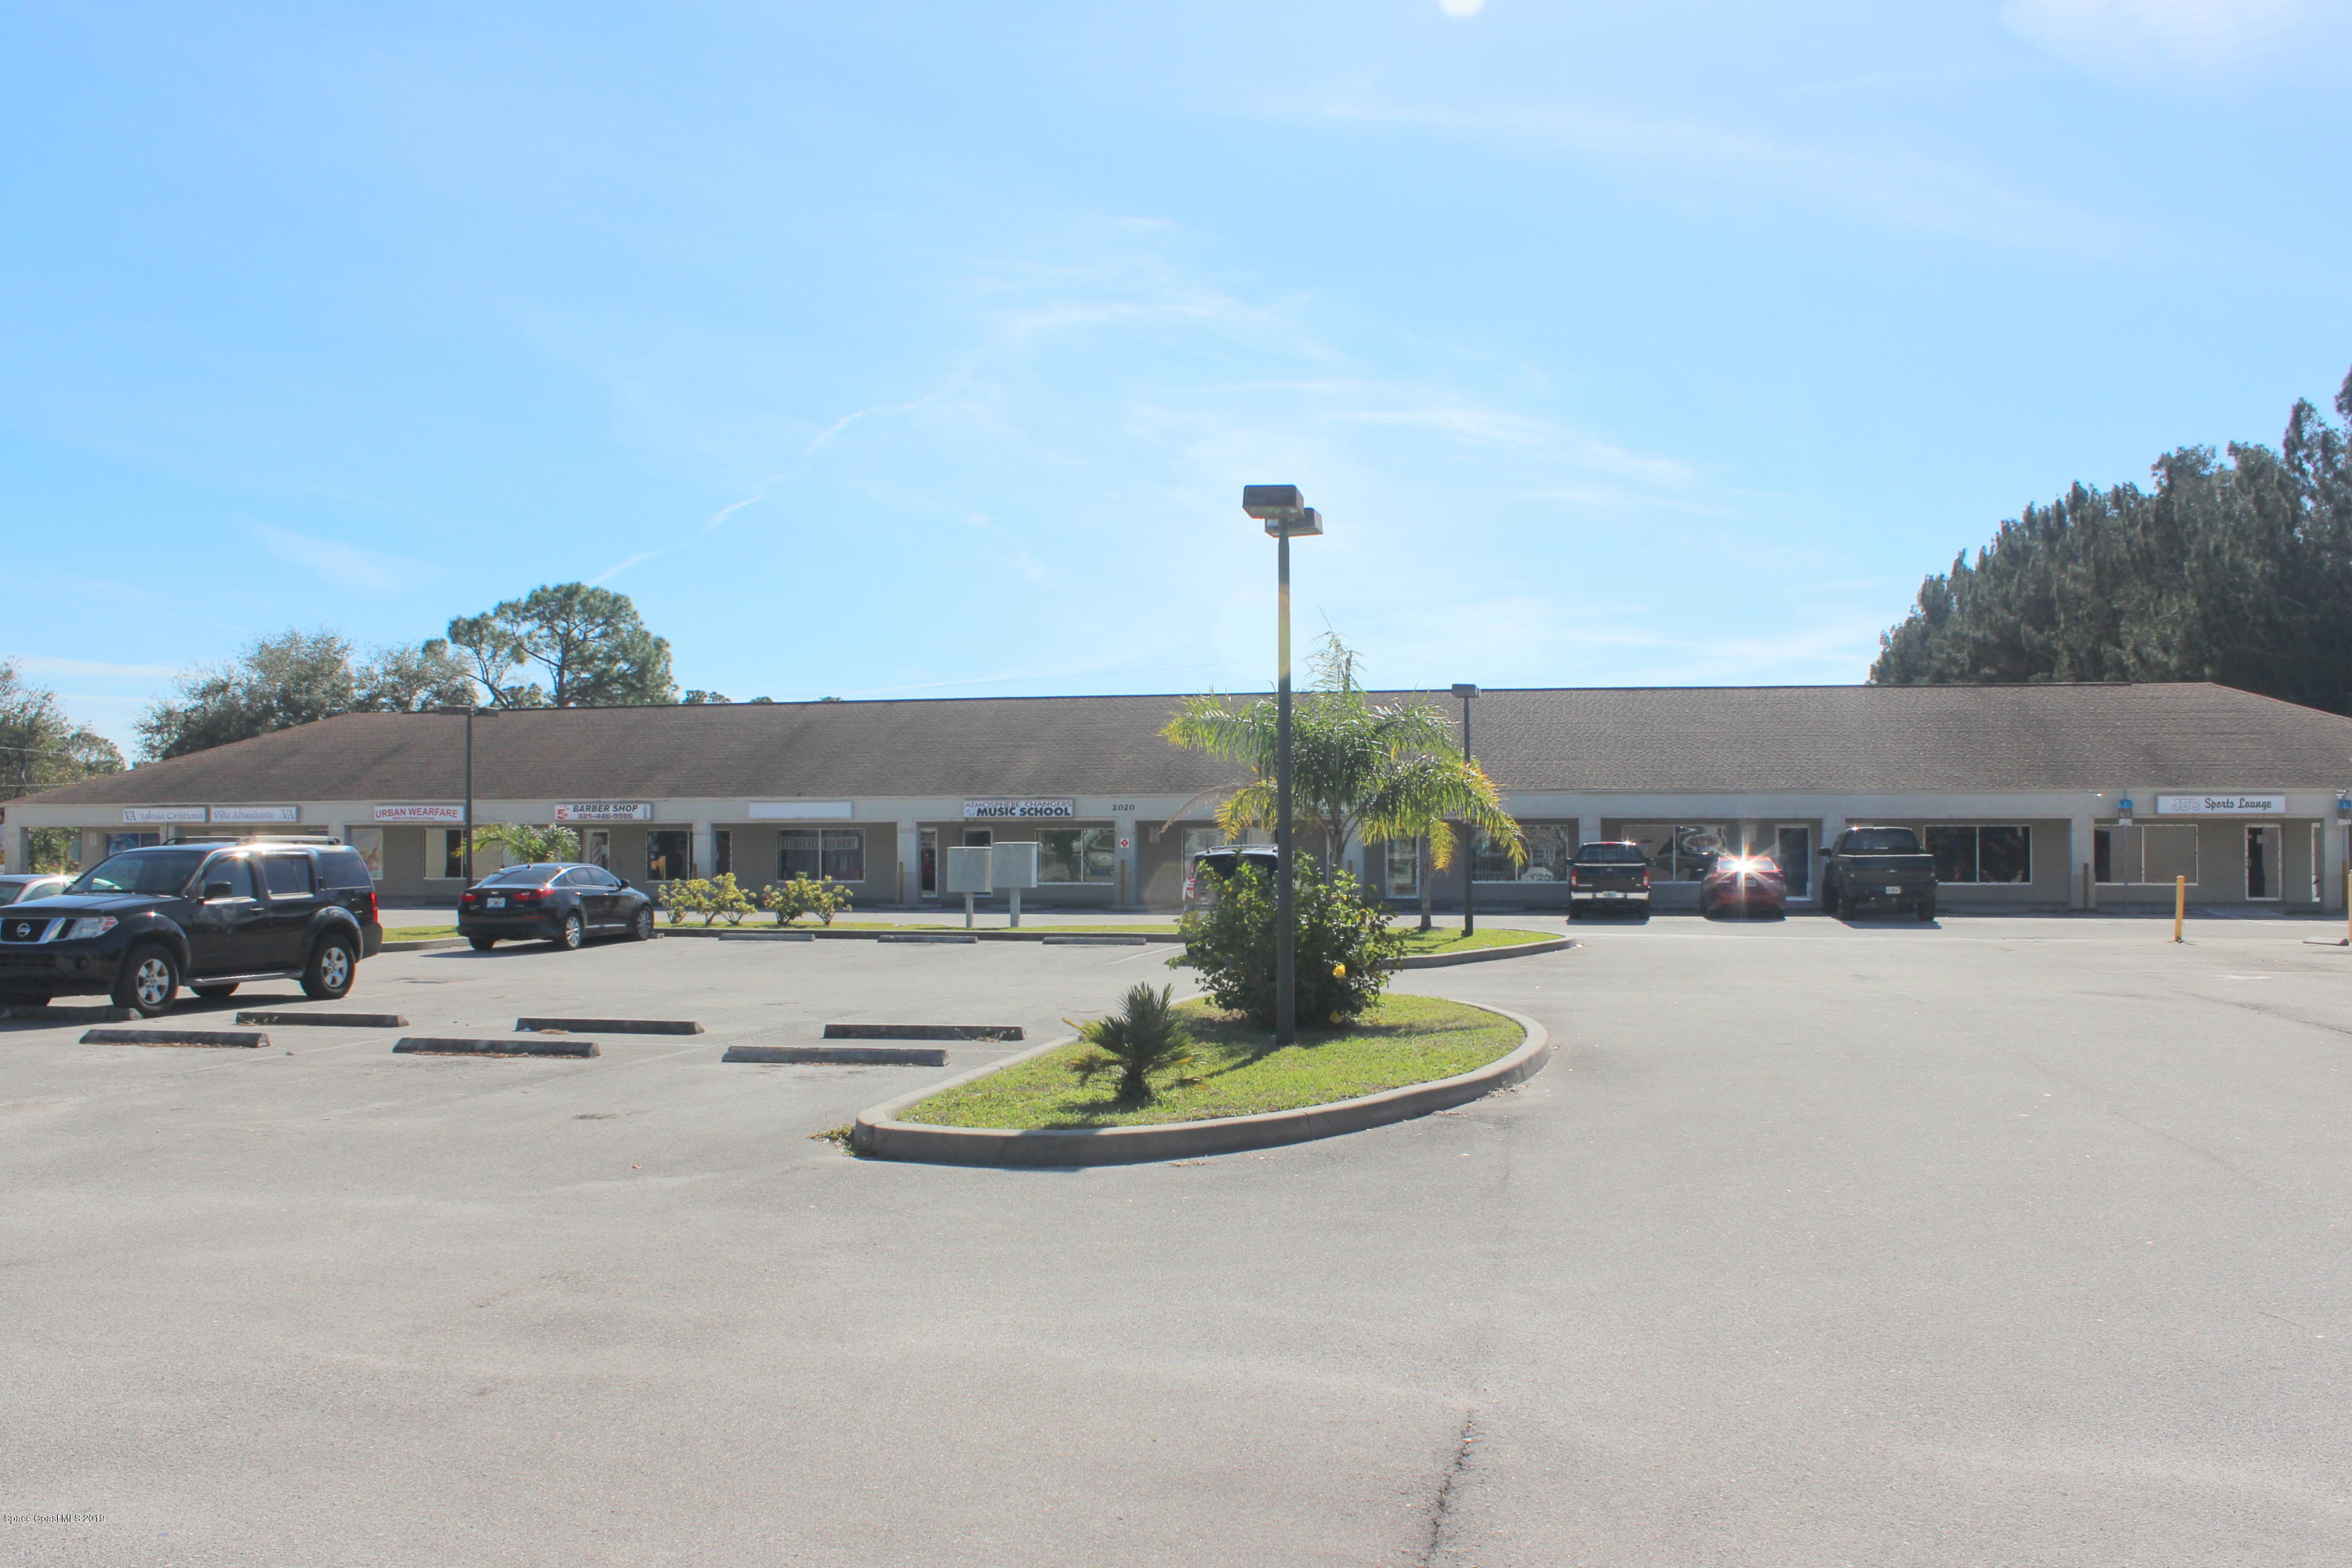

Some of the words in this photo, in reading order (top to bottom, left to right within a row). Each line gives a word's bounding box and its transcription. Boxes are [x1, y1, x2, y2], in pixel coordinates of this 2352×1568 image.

[2205, 797, 2234, 810] Sports
[2238, 797, 2271, 810] Lounge
[124, 810, 137, 821] VA
[140, 810, 165, 823] Iglesia
[166, 811, 203, 820] Cristiana
[212, 811, 231, 820] Vida
[233, 809, 274, 819] Abundante
[281, 808, 295, 820] VA
[376, 808, 406, 818] URBAN
[408, 808, 458, 818] WEARFARE
[976, 808, 1016, 817] MUSIC
[1019, 808, 1071, 816] SCHOOL
